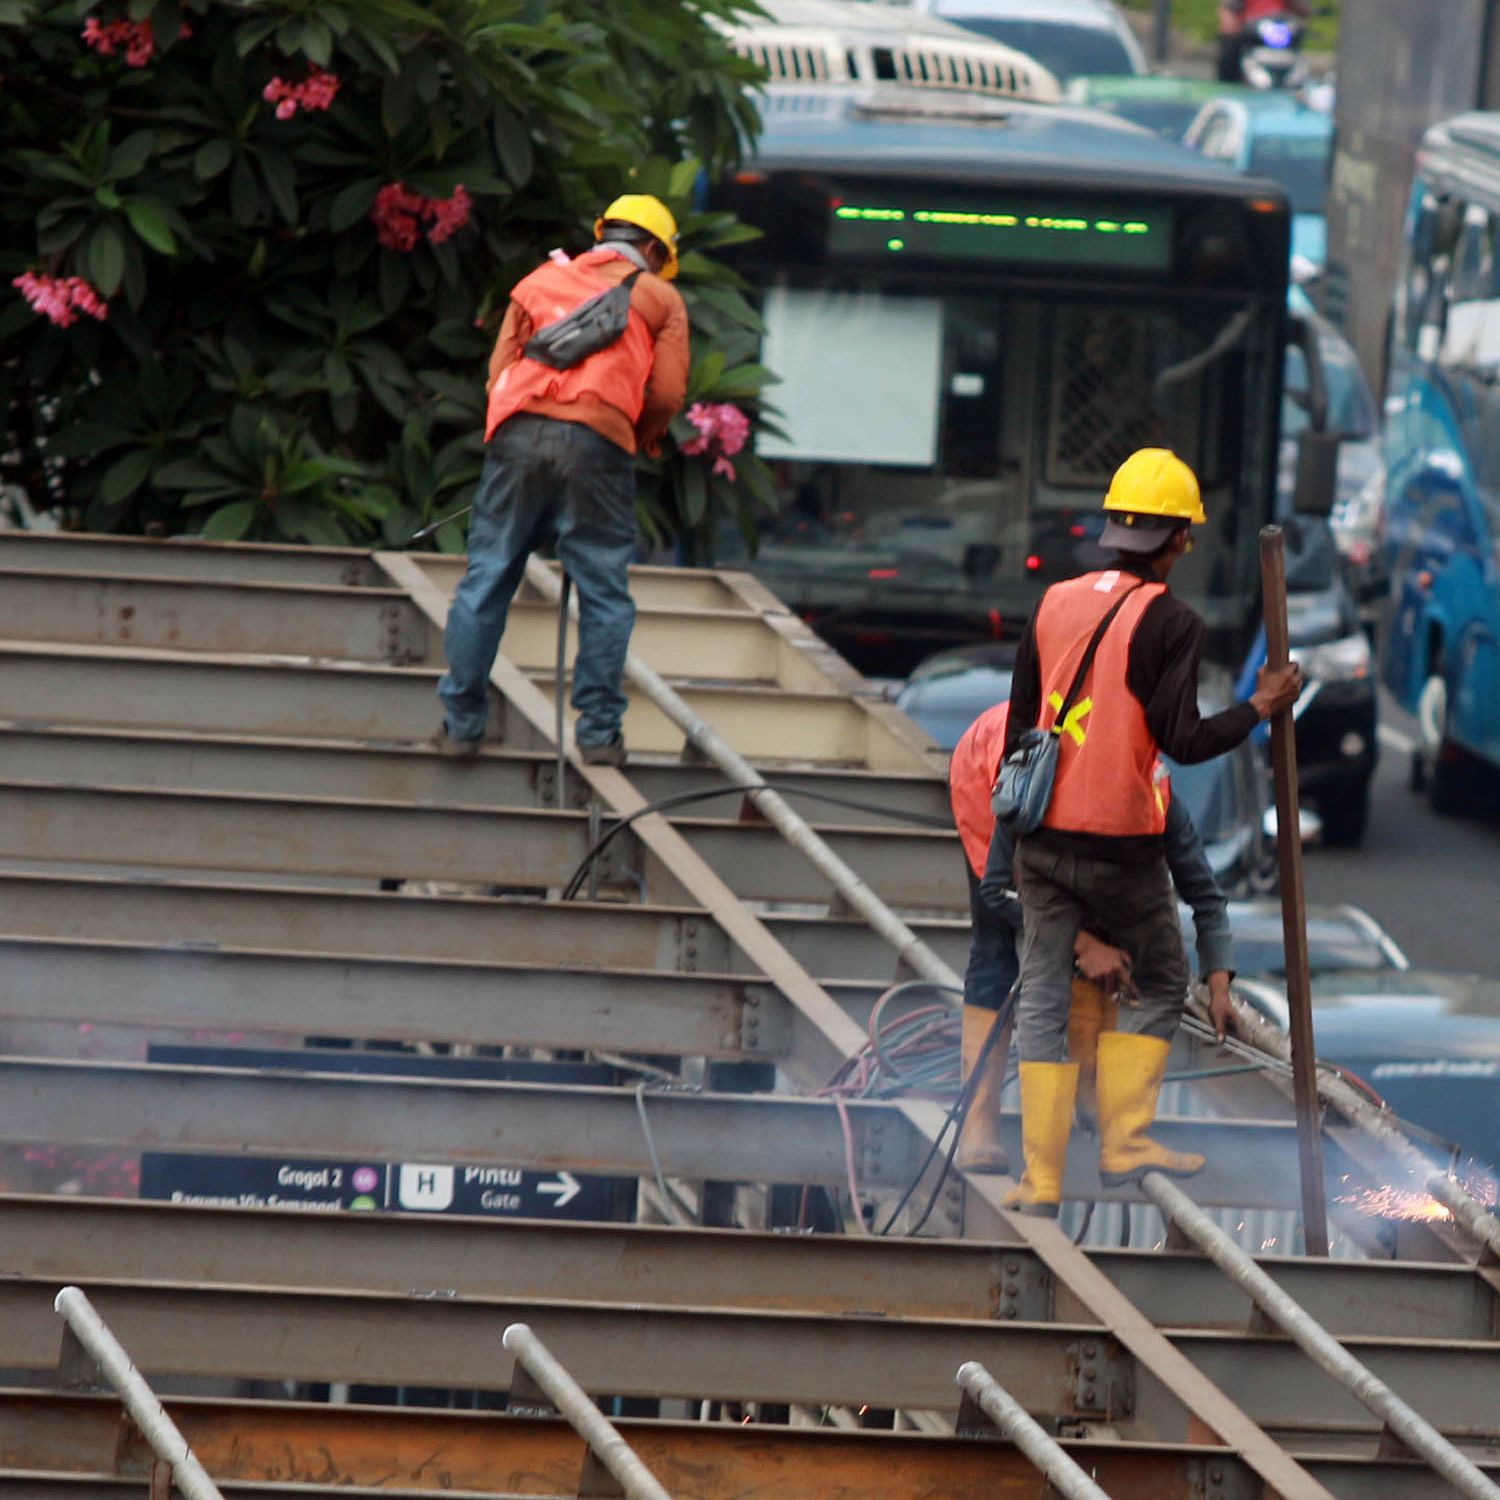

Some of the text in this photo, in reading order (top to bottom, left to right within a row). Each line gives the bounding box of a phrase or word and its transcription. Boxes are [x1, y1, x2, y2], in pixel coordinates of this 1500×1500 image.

[277, 1165, 328, 1190] Grogol
[331, 1168, 343, 1188] 2
[417, 1171, 436, 1194] H
[464, 1166, 522, 1187] Pintu
[481, 1189, 521, 1211] Gate
